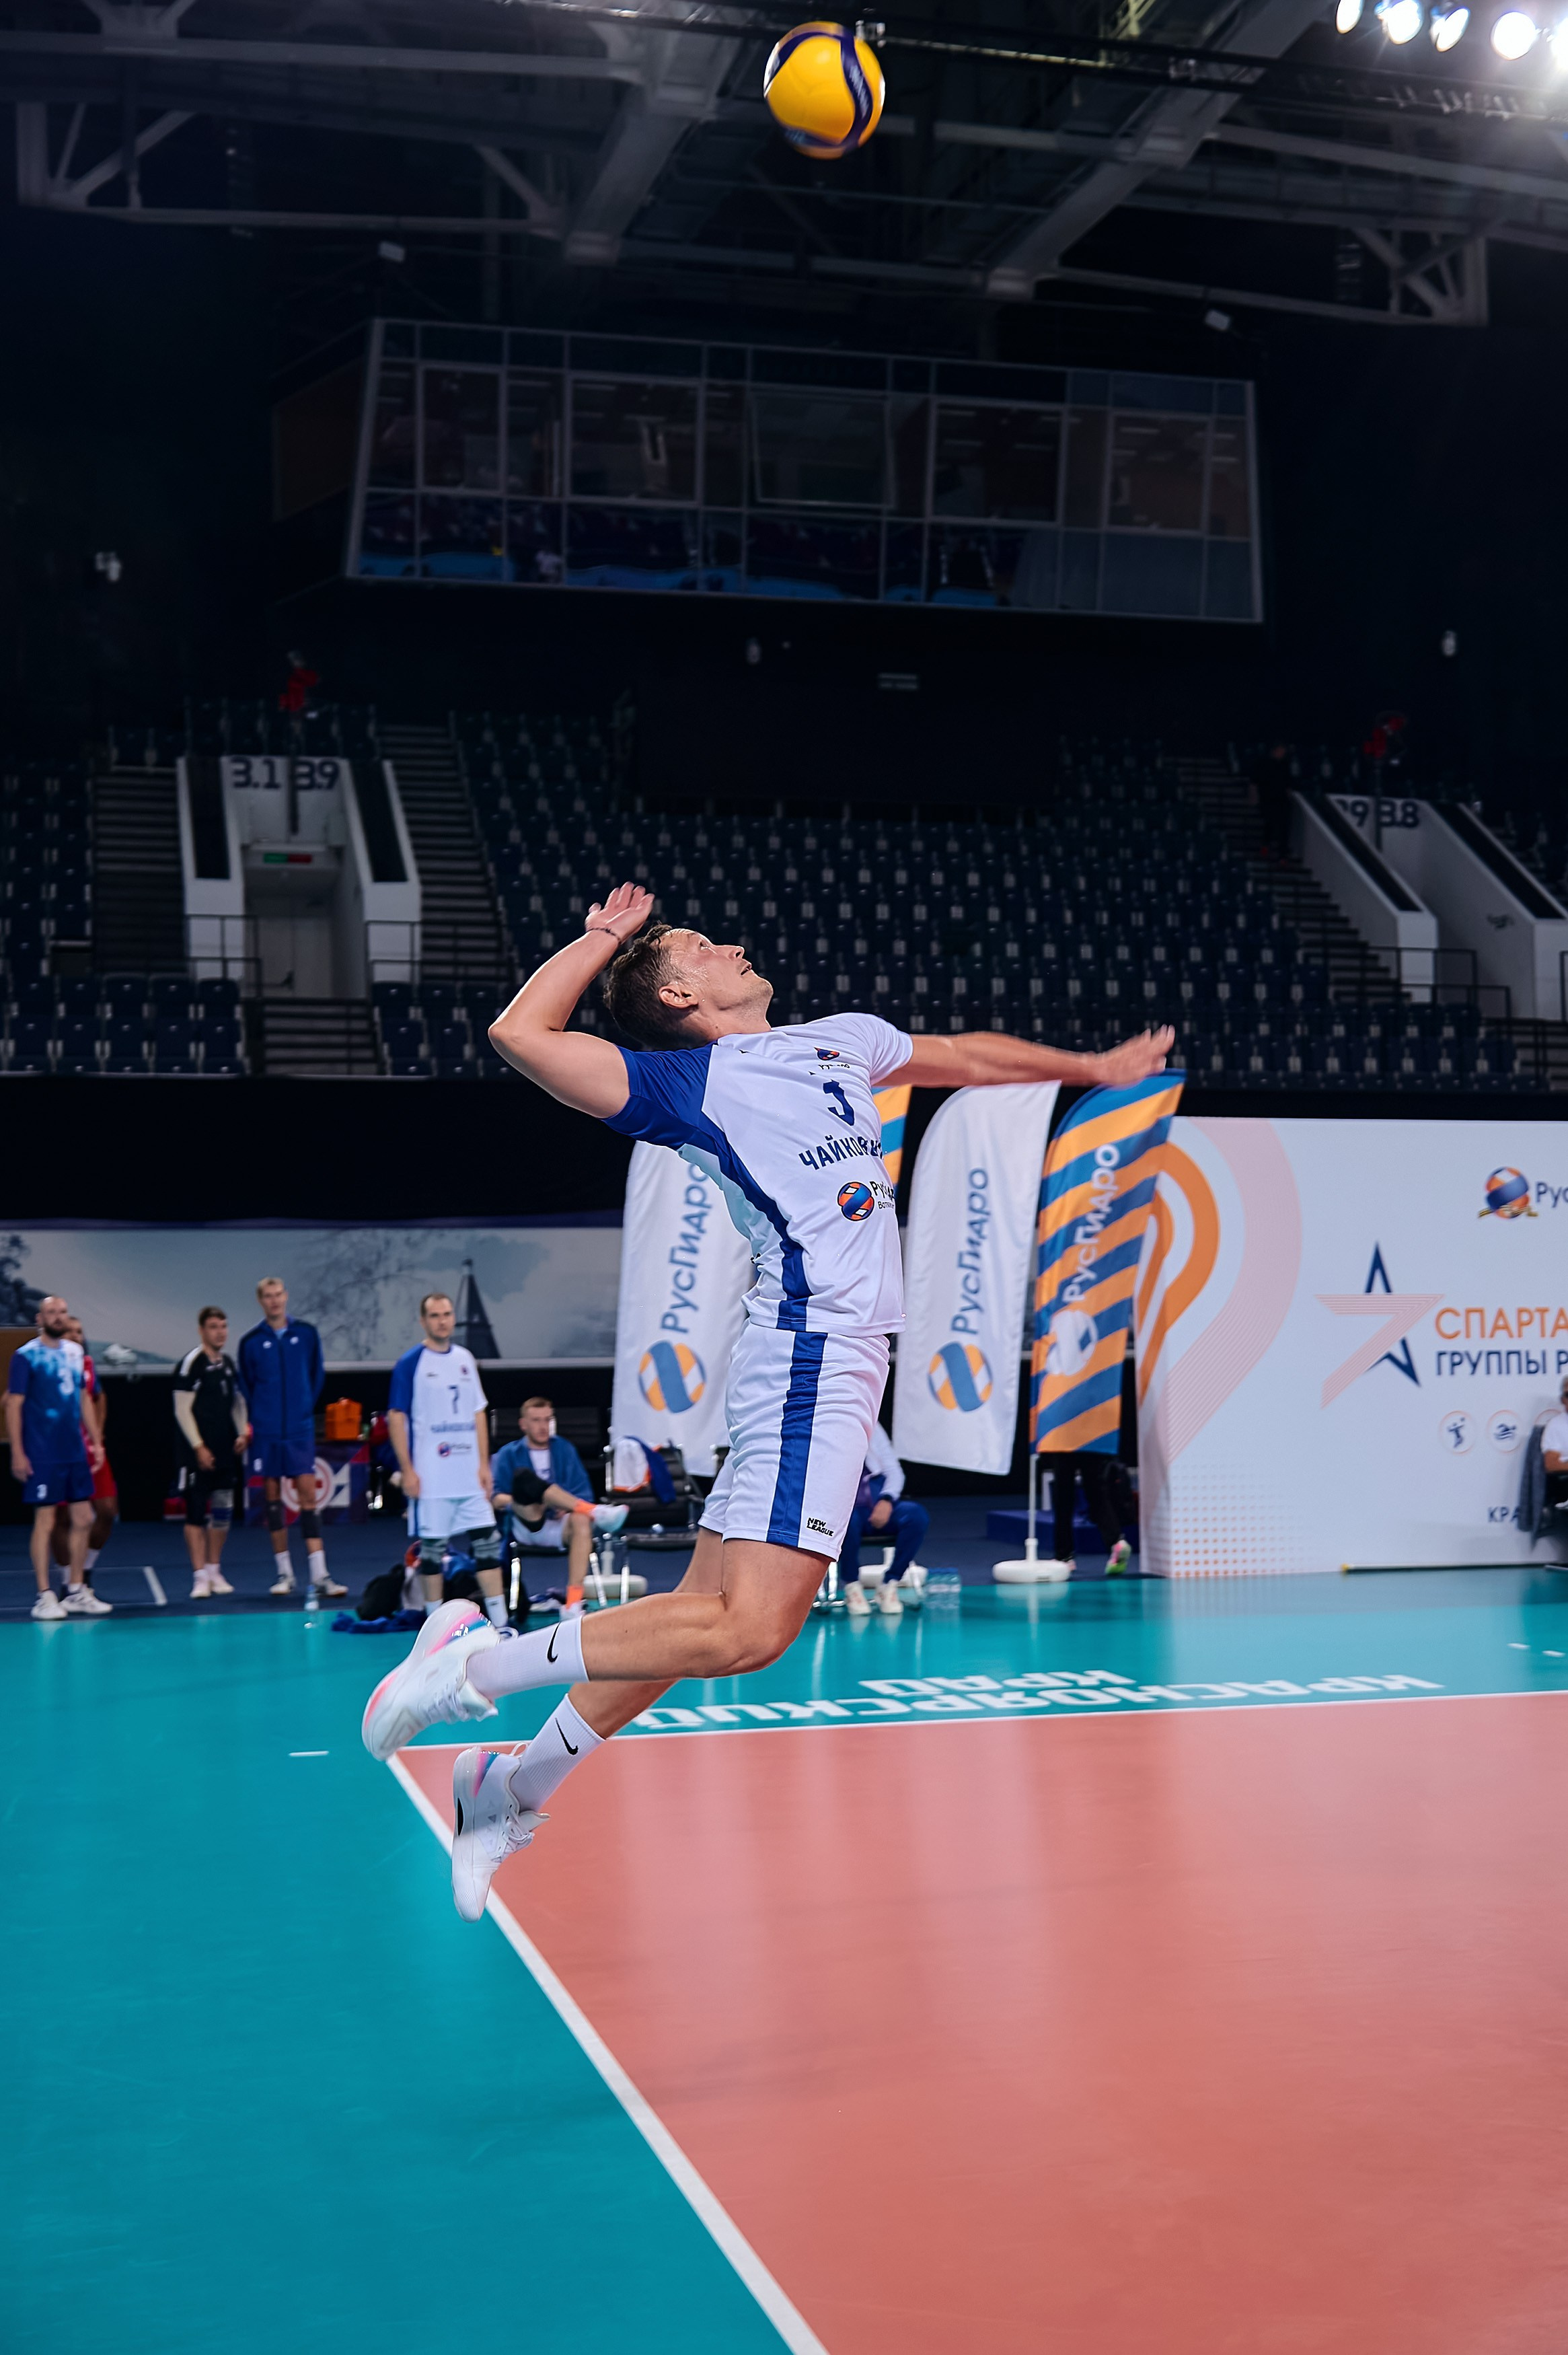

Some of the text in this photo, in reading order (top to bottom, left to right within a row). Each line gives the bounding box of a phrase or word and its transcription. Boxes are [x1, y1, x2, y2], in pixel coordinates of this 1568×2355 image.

[231, 756, 281, 789] 3.1
[1061, 1144, 1120, 1303] РусГидро
[950, 1168, 991, 1335] РусГидро
[1437, 1350, 1546, 1375] ГРУППЫ
[448, 1385, 459, 1414] 7
[807, 1517, 826, 1527] NEW
[807, 1523, 834, 1537] LEAGUE
[858, 1669, 1136, 1698] КРАЙ
[632, 1674, 1446, 1729] КРАСНОЯРСКИЙ
